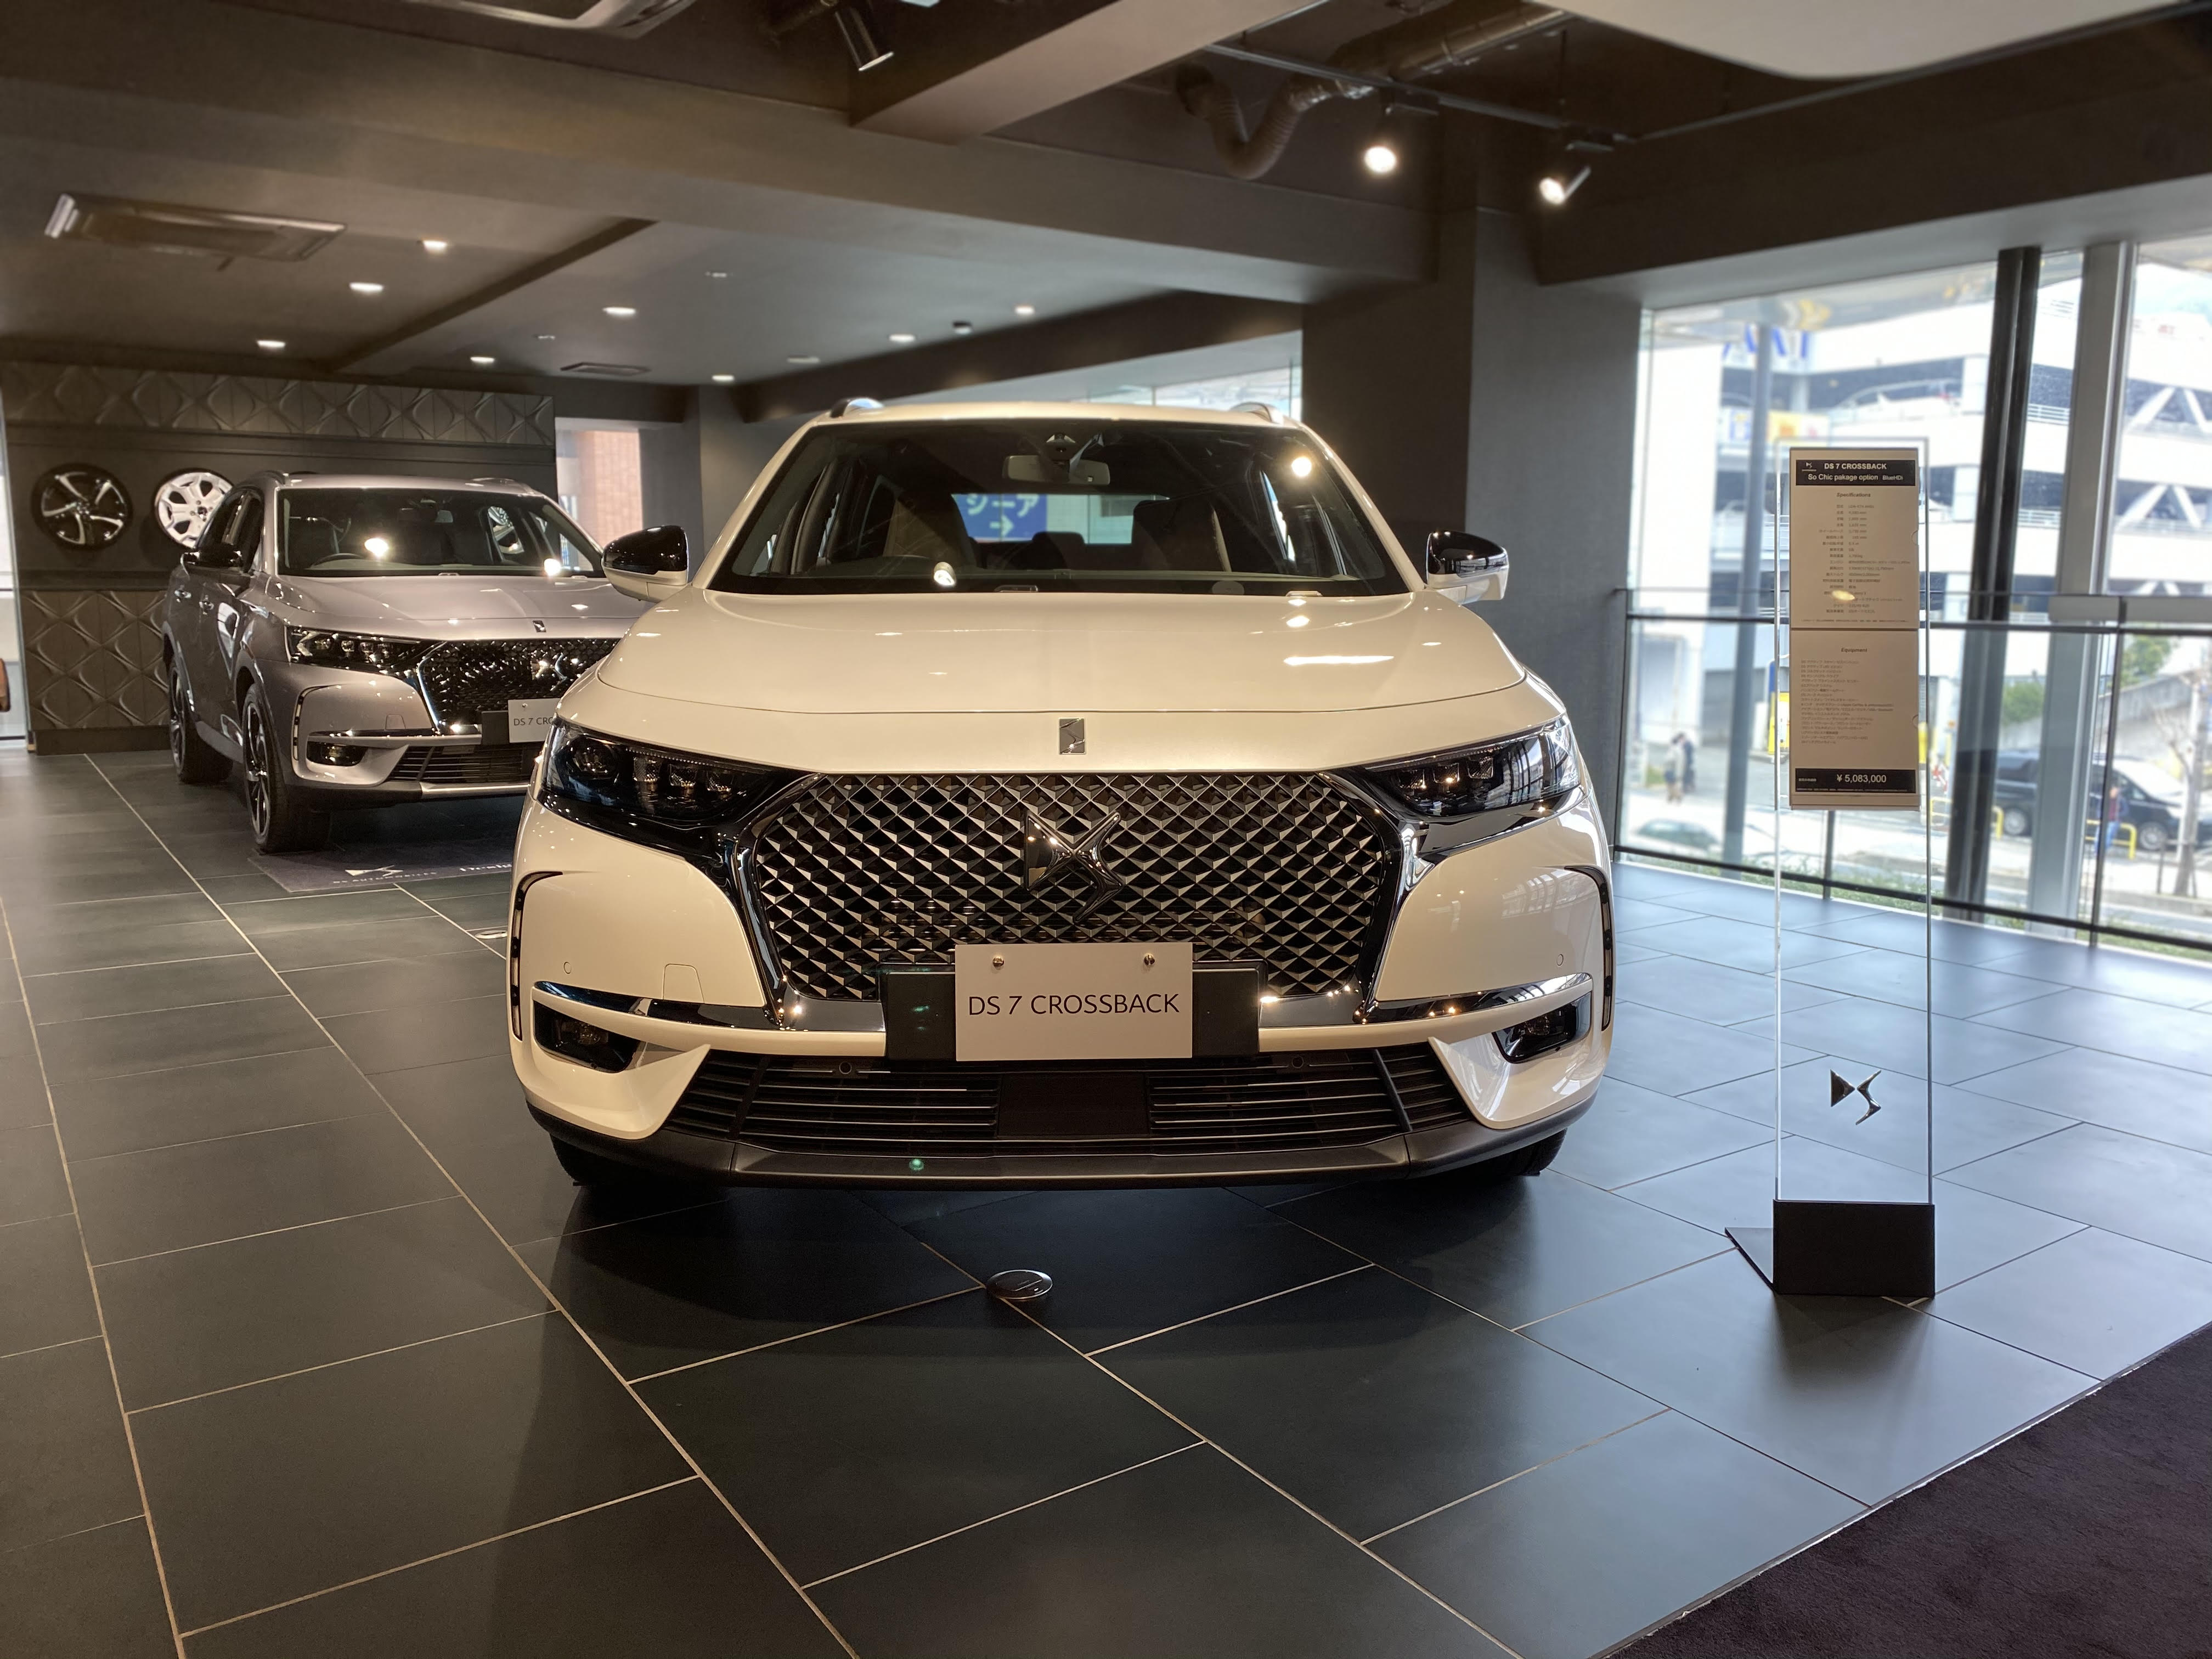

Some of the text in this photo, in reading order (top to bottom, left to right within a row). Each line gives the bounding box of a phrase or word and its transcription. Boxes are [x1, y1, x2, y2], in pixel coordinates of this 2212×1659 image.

[514, 718, 526, 726] DS
[1844, 774, 1887, 783] 5,083,000
[969, 994, 1180, 1015] DS 7 CROSSBACK
